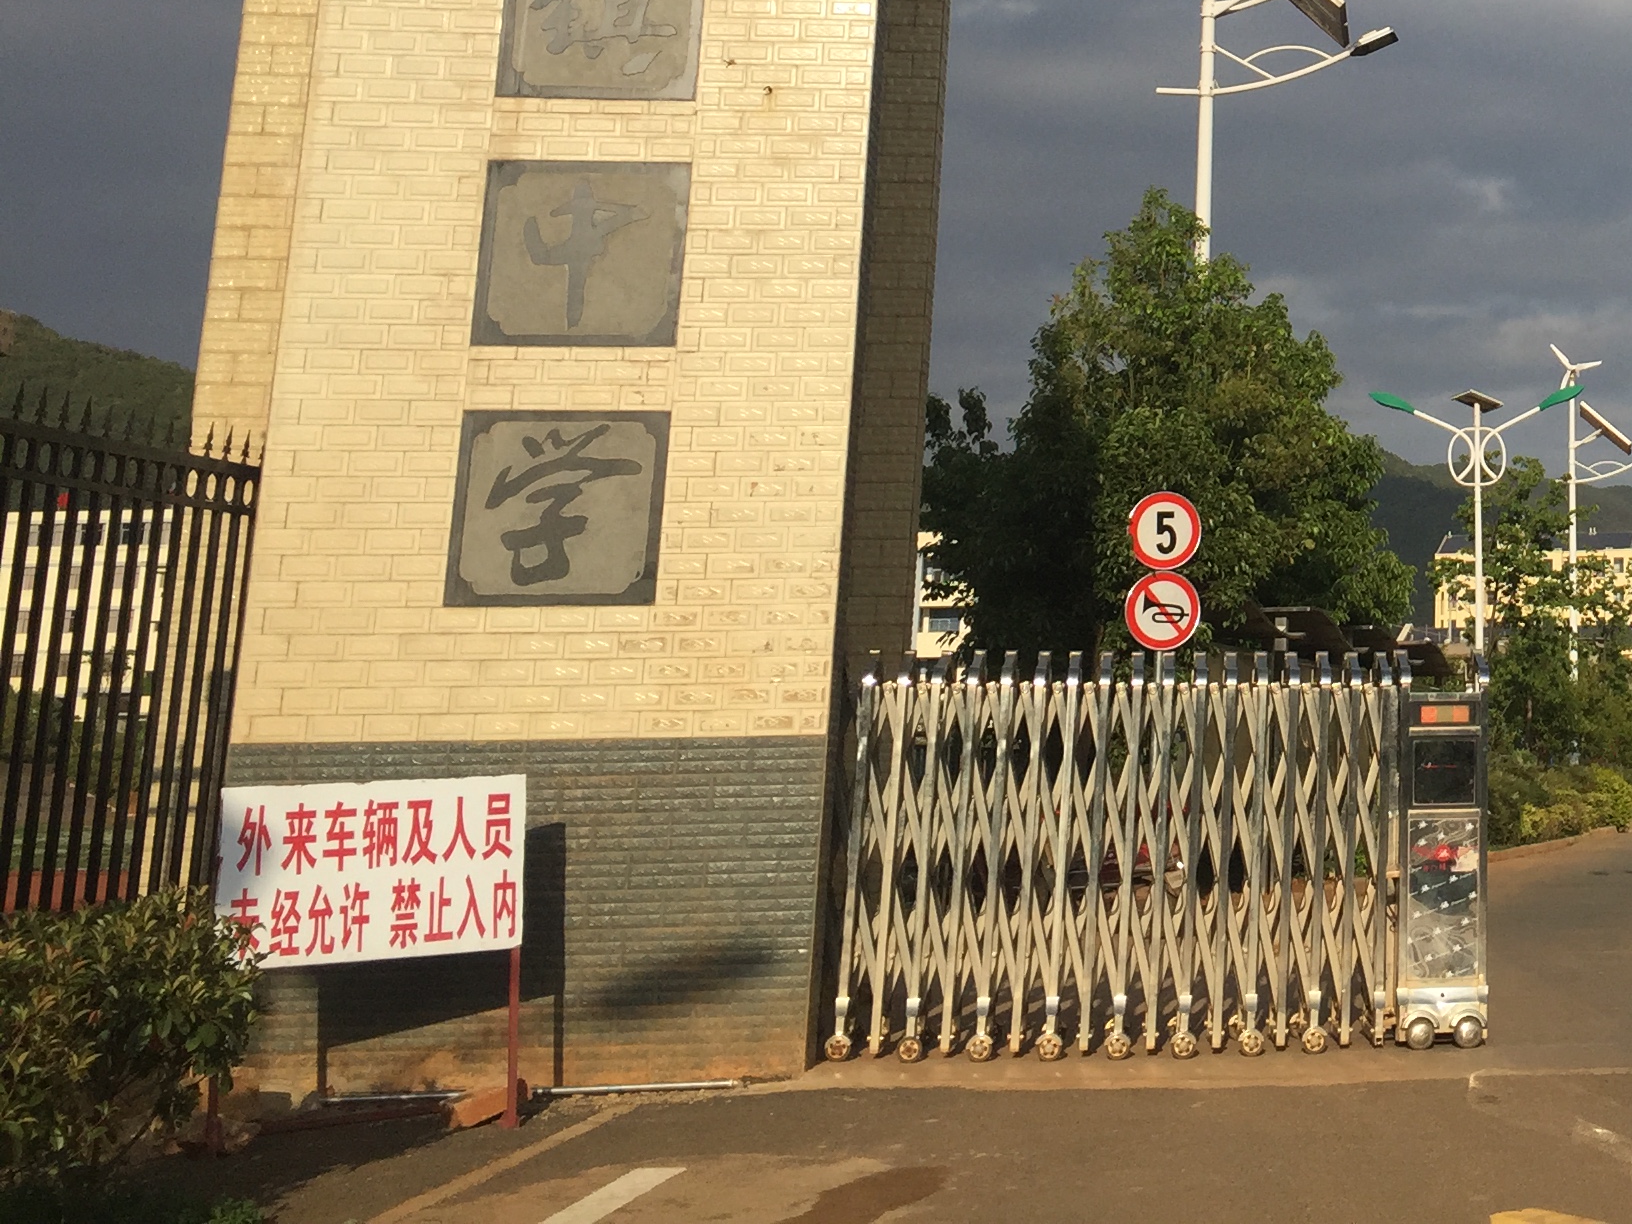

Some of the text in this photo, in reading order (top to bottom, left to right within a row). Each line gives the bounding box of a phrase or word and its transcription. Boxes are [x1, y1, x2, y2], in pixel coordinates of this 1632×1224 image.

[1156, 511, 1177, 554] 5
[237, 794, 513, 876] 外来车辆及人员
